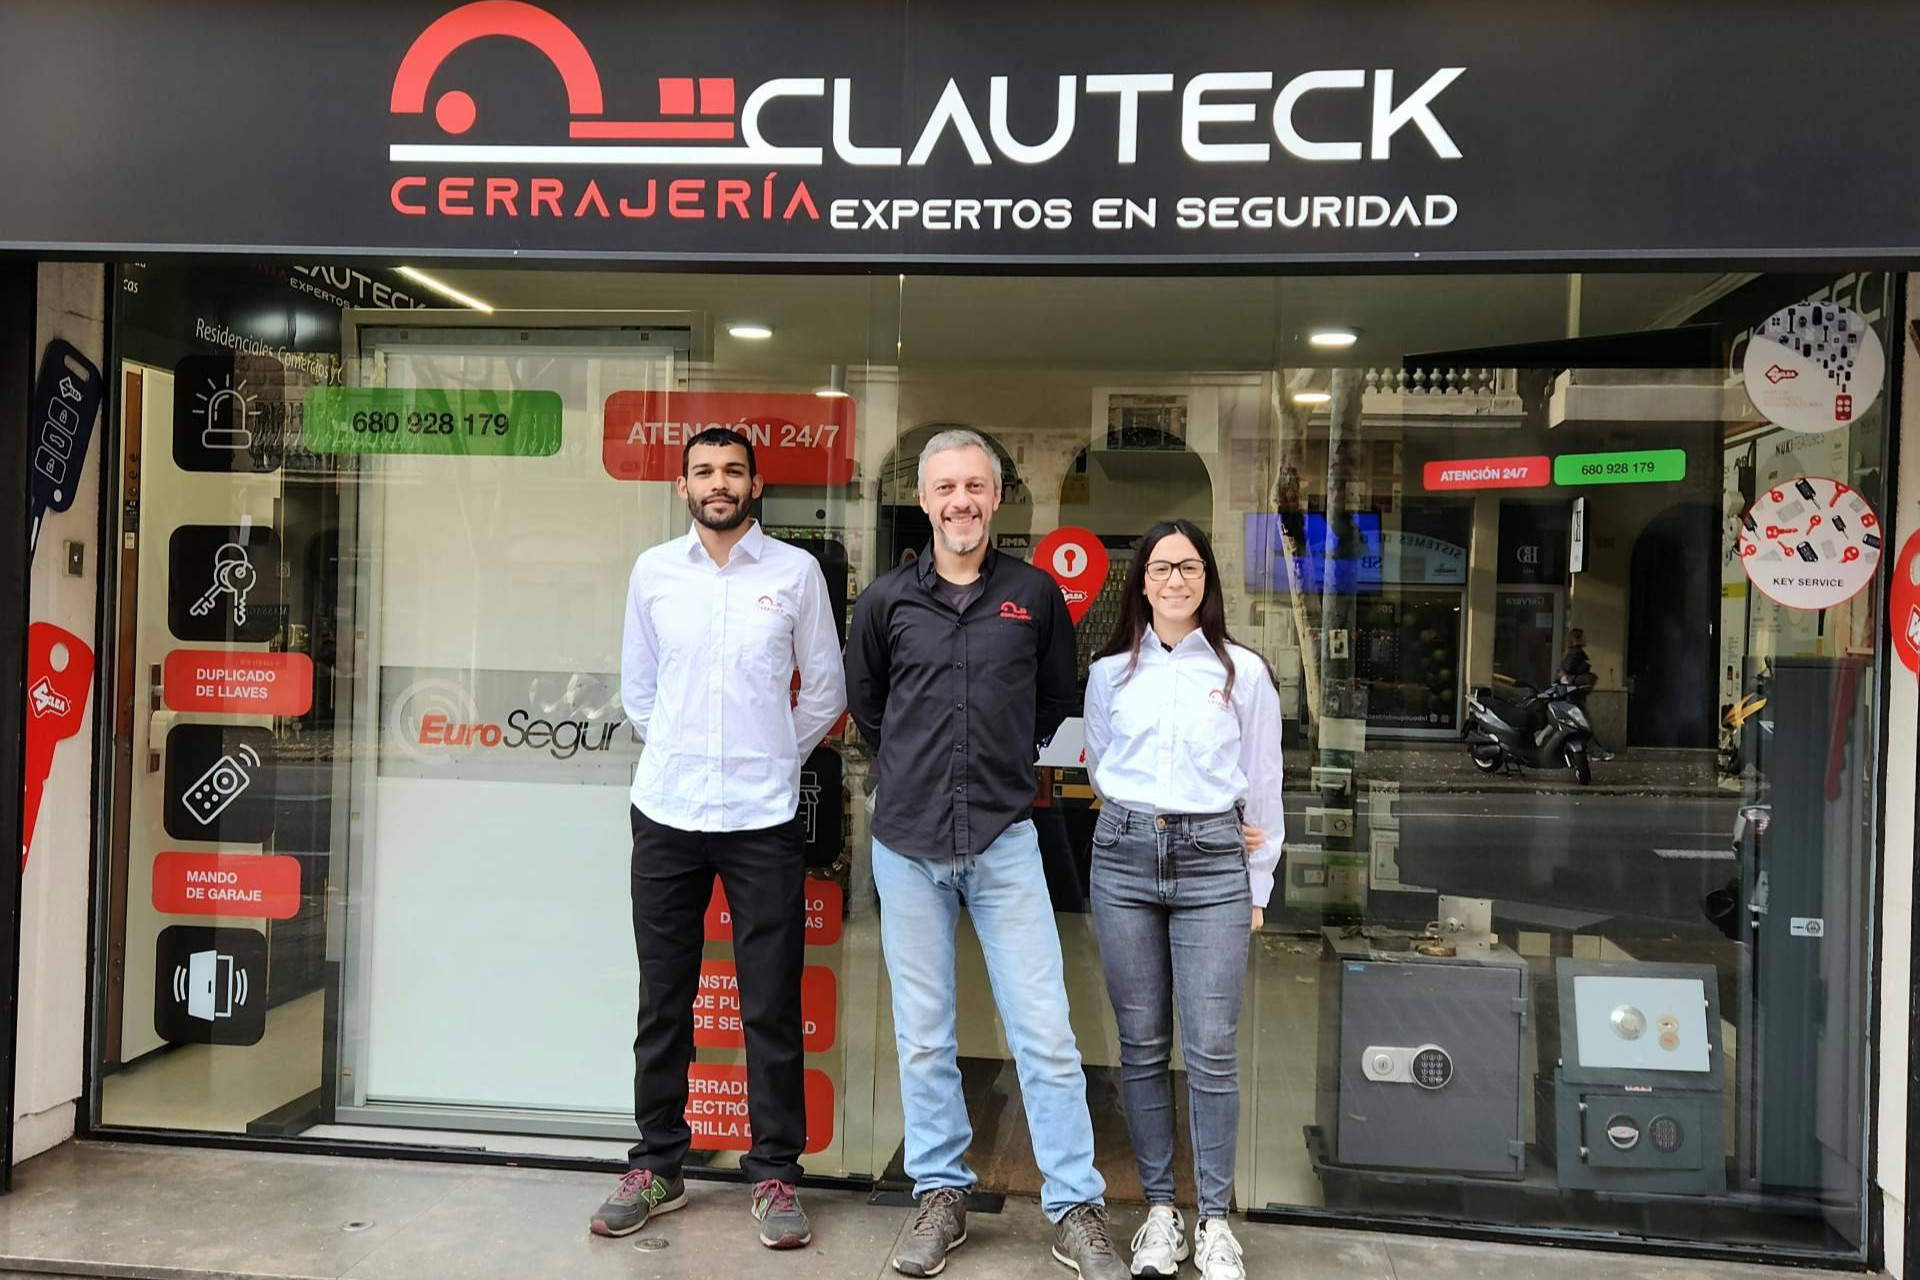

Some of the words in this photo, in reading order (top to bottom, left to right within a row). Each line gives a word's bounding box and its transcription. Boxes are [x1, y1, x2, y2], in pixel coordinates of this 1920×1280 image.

[740, 67, 1467, 166] CLAUTECK
[390, 172, 821, 221] CERRAJERÍA
[831, 198, 1073, 231] EXPERTOS
[1092, 197, 1157, 230] EN
[1176, 194, 1459, 230] SEGURIDAD
[196, 317, 274, 358] Residenciales
[278, 345, 329, 380] Comercios
[352, 410, 400, 434] 680
[407, 411, 455, 435] 928
[463, 412, 510, 436] 179
[627, 417, 771, 447] ATENÓN
[780, 424, 840, 448] 24/7
[1440, 466, 1501, 482] ATENCIÓN
[1503, 467, 1529, 480] 24/7
[1581, 463, 1603, 476] 680
[1606, 463, 1629, 475] 928
[1633, 462, 1655, 473] 179
[1773, 577, 1795, 586] KEY
[1798, 578, 1844, 588] SERVICE
[196, 668, 276, 683] DUPLICADO
[196, 685, 214, 697] DE
[217, 686, 268, 699] LLAVES
[186, 870, 238, 884] MANDO
[186, 887, 205, 899] DE
[207, 888, 262, 902] GARAJE
[719, 996, 741, 1011] PU
[694, 1014, 714, 1029] DE
